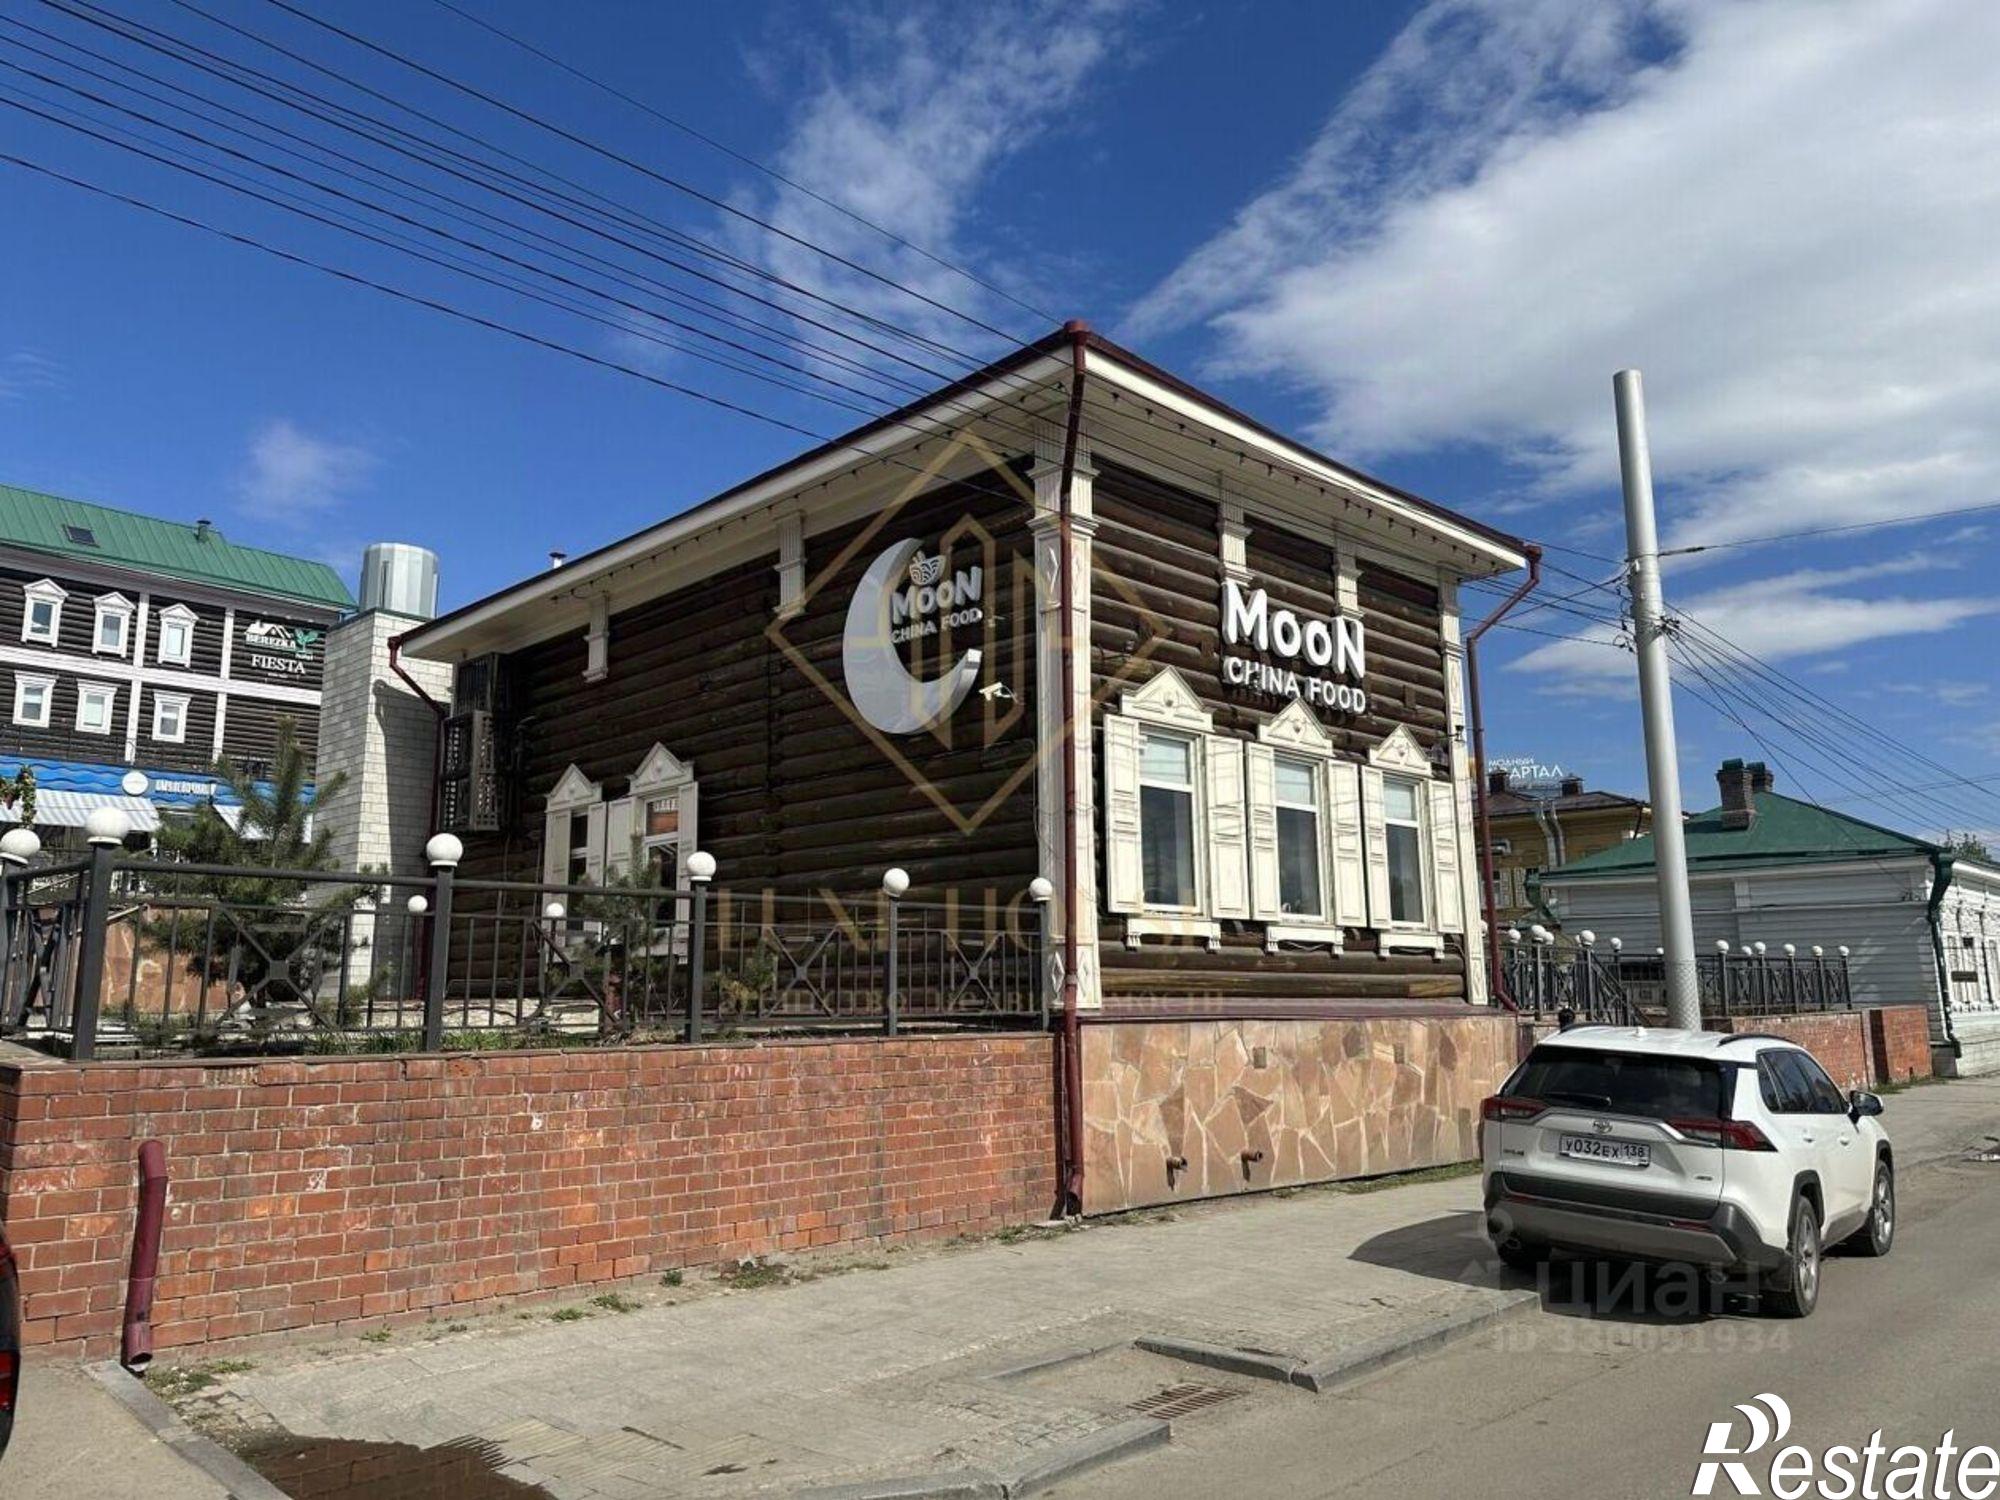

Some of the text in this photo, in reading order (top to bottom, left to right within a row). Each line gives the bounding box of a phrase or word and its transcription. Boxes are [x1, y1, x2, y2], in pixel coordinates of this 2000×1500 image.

[890, 566, 982, 624] MOON
[891, 608, 983, 644] CHINA FOOD
[1222, 581, 1366, 679] MOON
[250, 654, 306, 675] FIESTA
[1223, 656, 1367, 714] CHINA FOOD
[1488, 764, 1564, 780] АРТАЛ
